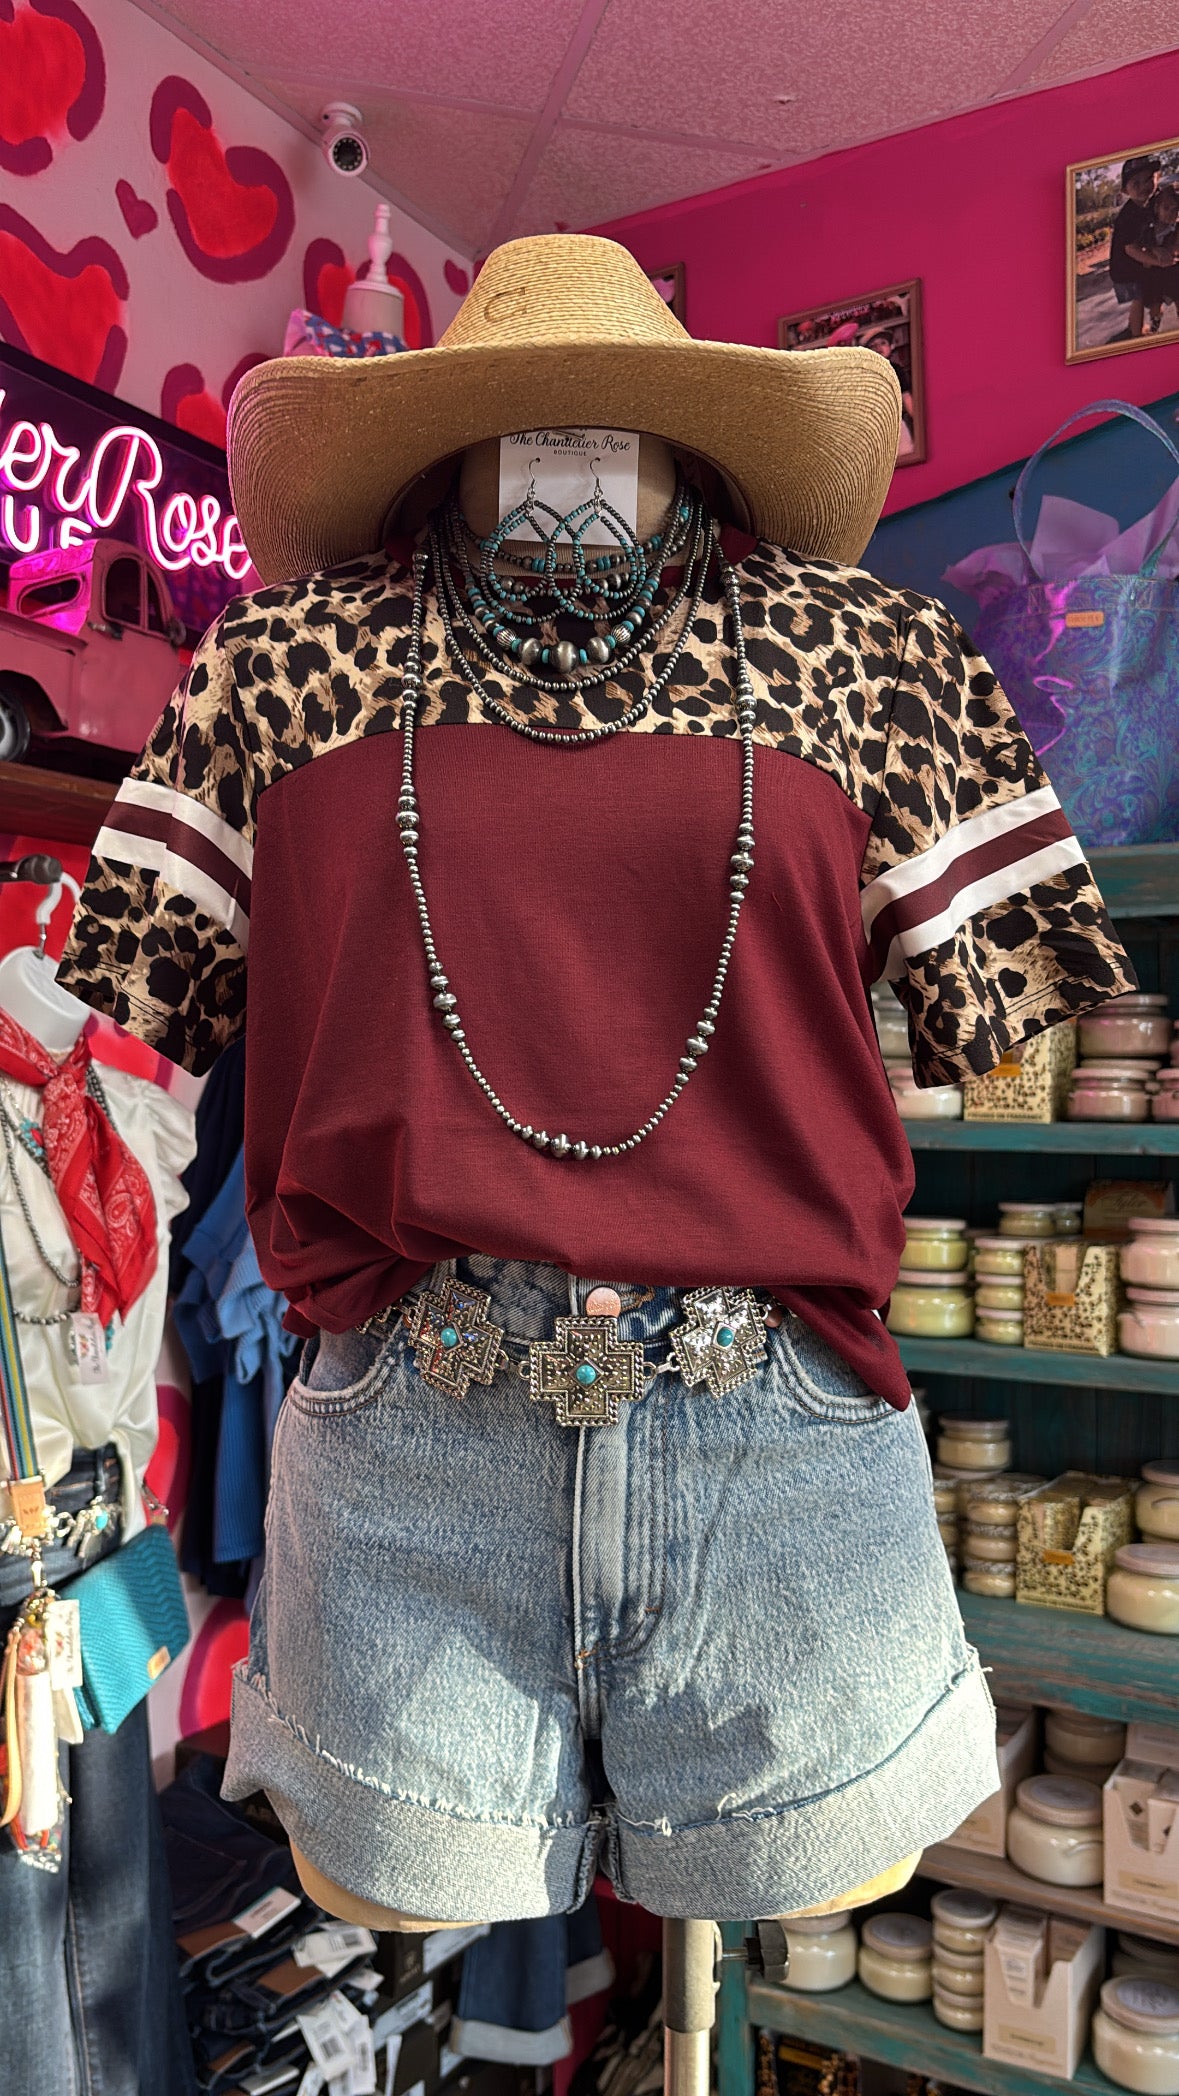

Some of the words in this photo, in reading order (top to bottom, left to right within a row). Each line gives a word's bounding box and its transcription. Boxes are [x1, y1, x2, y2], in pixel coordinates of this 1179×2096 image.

[510, 432, 534, 445] The
[601, 434, 631, 453] Rose
[0, 418, 90, 513] er
[86, 425, 253, 580] Rose
